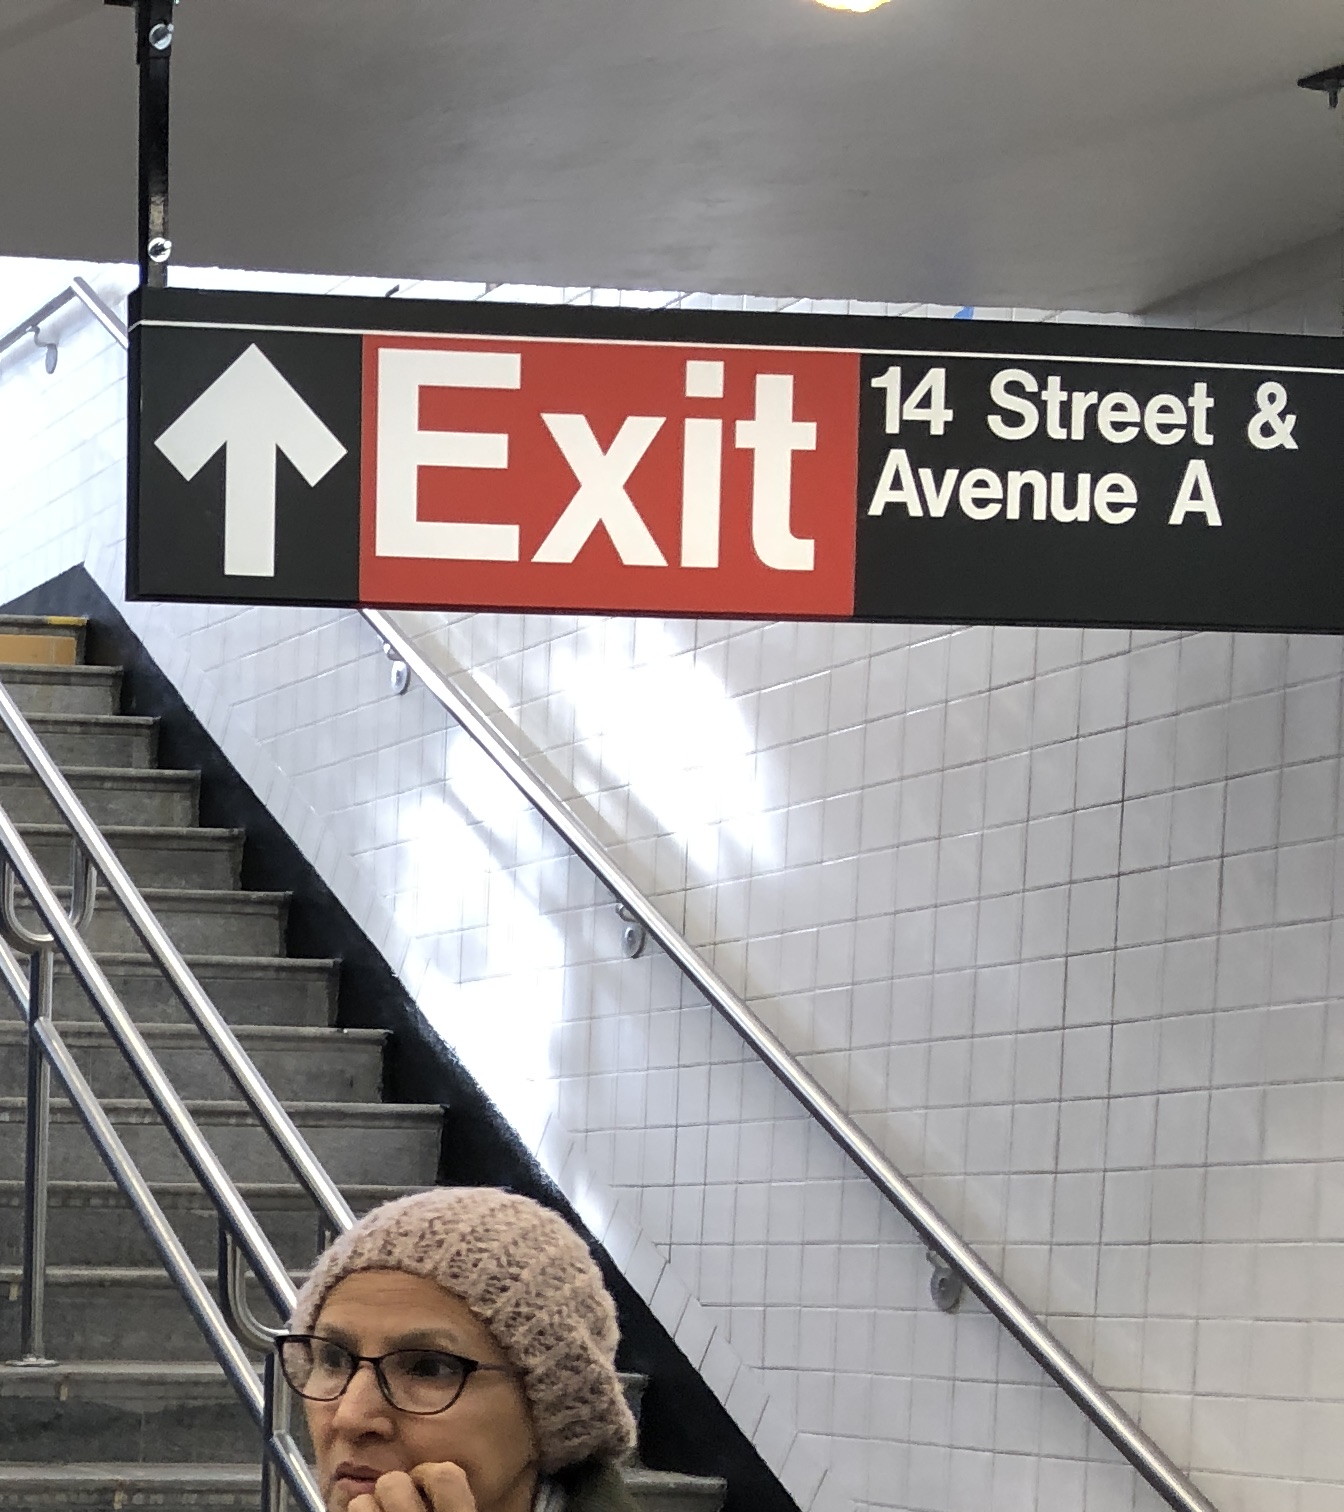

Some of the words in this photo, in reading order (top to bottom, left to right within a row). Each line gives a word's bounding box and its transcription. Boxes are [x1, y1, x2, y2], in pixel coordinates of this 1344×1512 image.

[869, 366, 954, 436] 14
[988, 368, 1215, 446] Street
[1248, 381, 1299, 450] &
[375, 347, 818, 572] Exit
[867, 448, 1138, 525] Avenue
[1169, 459, 1223, 527] A
